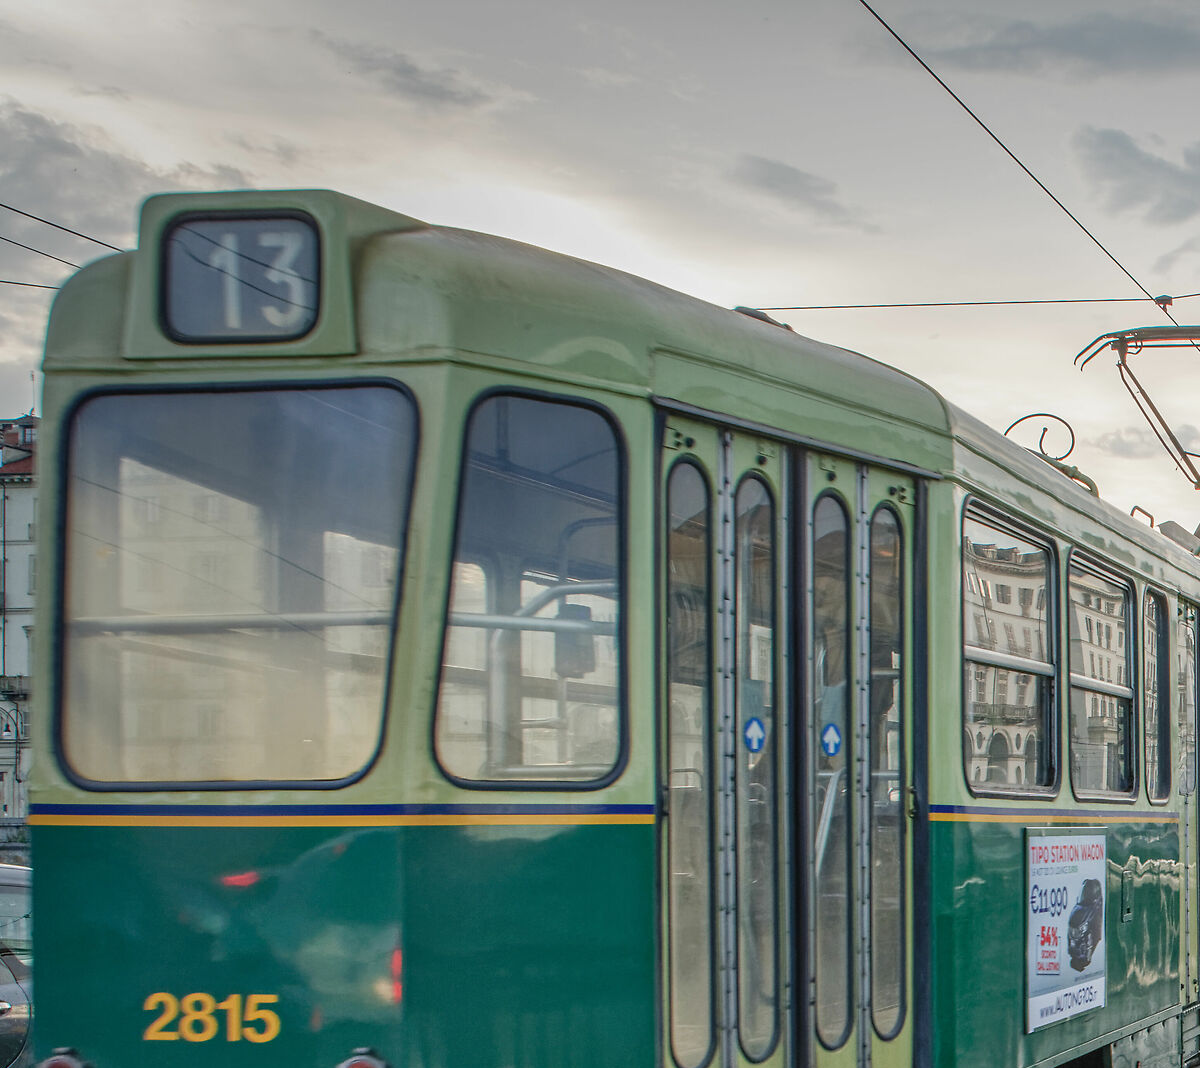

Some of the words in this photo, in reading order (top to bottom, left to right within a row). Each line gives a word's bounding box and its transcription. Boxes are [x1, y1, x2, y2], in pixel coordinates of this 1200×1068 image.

[210, 231, 305, 329] 13
[1031, 846, 1050, 864] TIPO
[1051, 845, 1080, 863] STATION
[1081, 843, 1105, 861] WAGON
[1040, 925, 1059, 947] 54%
[142, 992, 281, 1043] 2815
